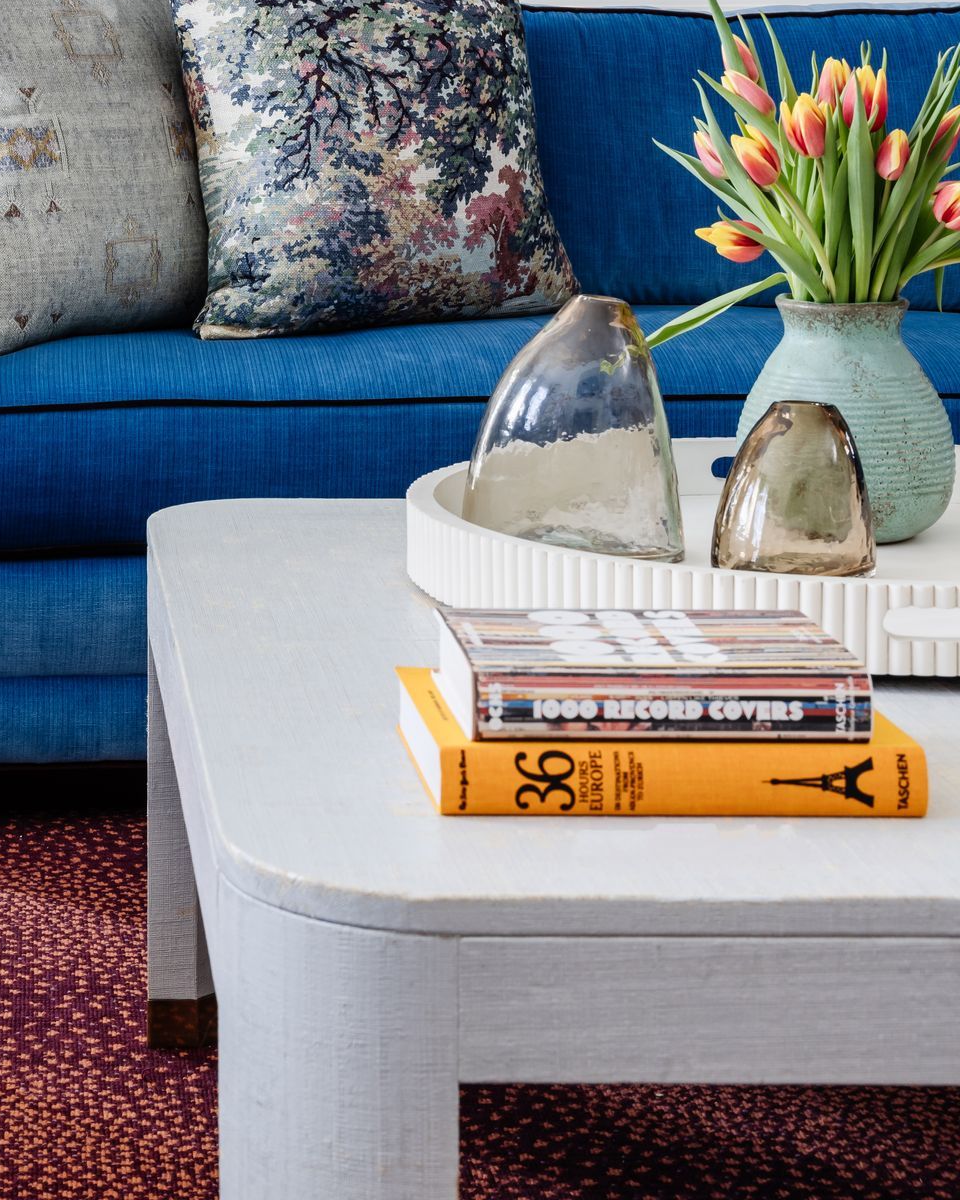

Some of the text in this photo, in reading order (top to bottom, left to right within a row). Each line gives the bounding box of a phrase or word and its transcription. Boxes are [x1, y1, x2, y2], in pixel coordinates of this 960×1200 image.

[532, 699, 804, 722] 1000 RECORD COVERS
[834, 682, 848, 734] TASCHEN
[514, 750, 576, 811] 36
[578, 761, 589, 803] HOURS
[588, 750, 604, 811] EUROPE
[896, 753, 910, 811] TASCHEN
